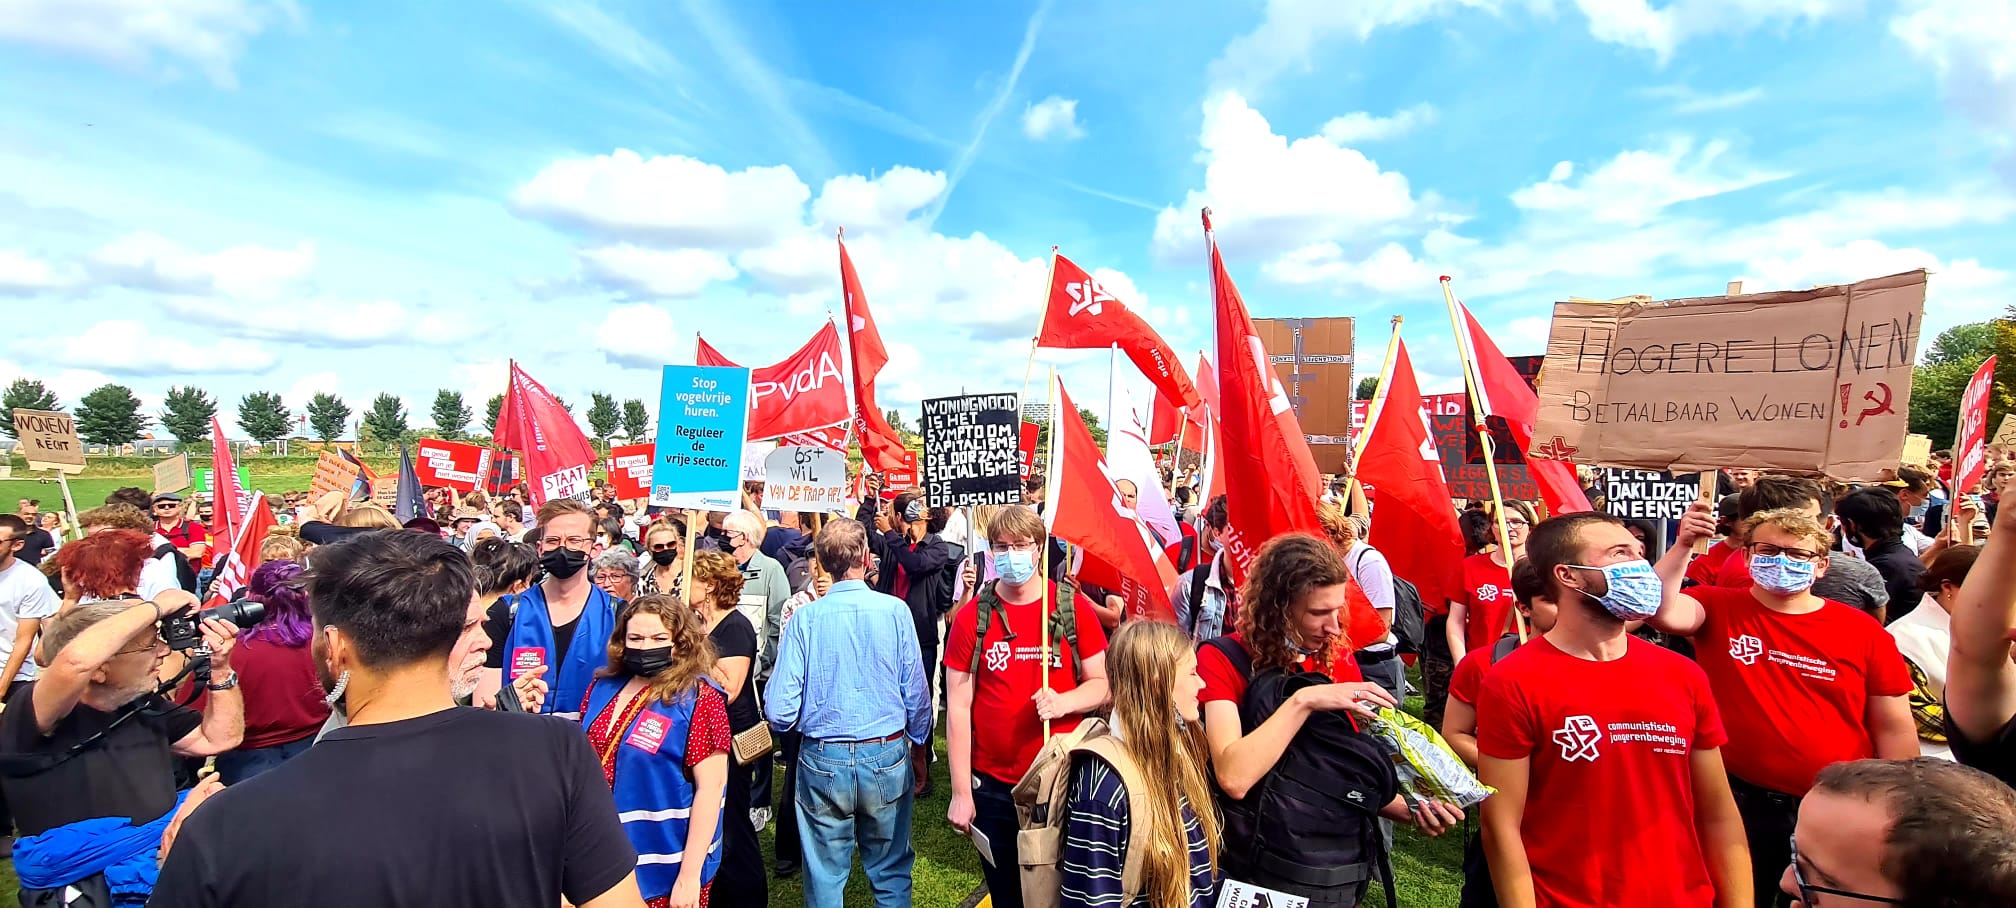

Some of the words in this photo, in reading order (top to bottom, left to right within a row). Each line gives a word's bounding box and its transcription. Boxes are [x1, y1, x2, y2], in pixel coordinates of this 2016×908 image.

[1577, 328, 1755, 376] HOGERE
[1772, 312, 1912, 378] LONEN
[692, 377, 717, 391] Stop
[751, 351, 843, 410] PvdA
[676, 391, 732, 406] vogelvrije
[923, 395, 1017, 415] WONINGNOOD
[1567, 390, 1719, 423] BETAALBAAR
[1730, 393, 1825, 422] WONEN
[684, 405, 719, 417] huren.
[15, 415, 70, 434] WONEN
[927, 415, 943, 429] IS
[947, 411, 978, 427] HET
[676, 425, 724, 440] Reguleer
[36, 438, 69, 451] RECHT
[692, 440, 705, 451] de
[926, 436, 1017, 454] KAPITALISME
[666, 453, 691, 466] vrije
[693, 455, 728, 467] sector.
[794, 447, 824, 464] 65+
[927, 454, 946, 466] DE
[545, 466, 583, 490] STAAT
[927, 461, 1018, 482] SOCIALISME
[558, 483, 575, 498] HET
[770, 484, 785, 501] VAN
[788, 485, 800, 501] DE
[803, 484, 825, 501] TRAP
[930, 481, 952, 495] DE
[1607, 481, 1699, 502] DAKLOZEN
[930, 489, 1020, 507] OPLOSSING
[1607, 501, 1628, 517] IN
[1607, 721, 1677, 733] communistische
[1610, 732, 1687, 747] jongerenbeweging
